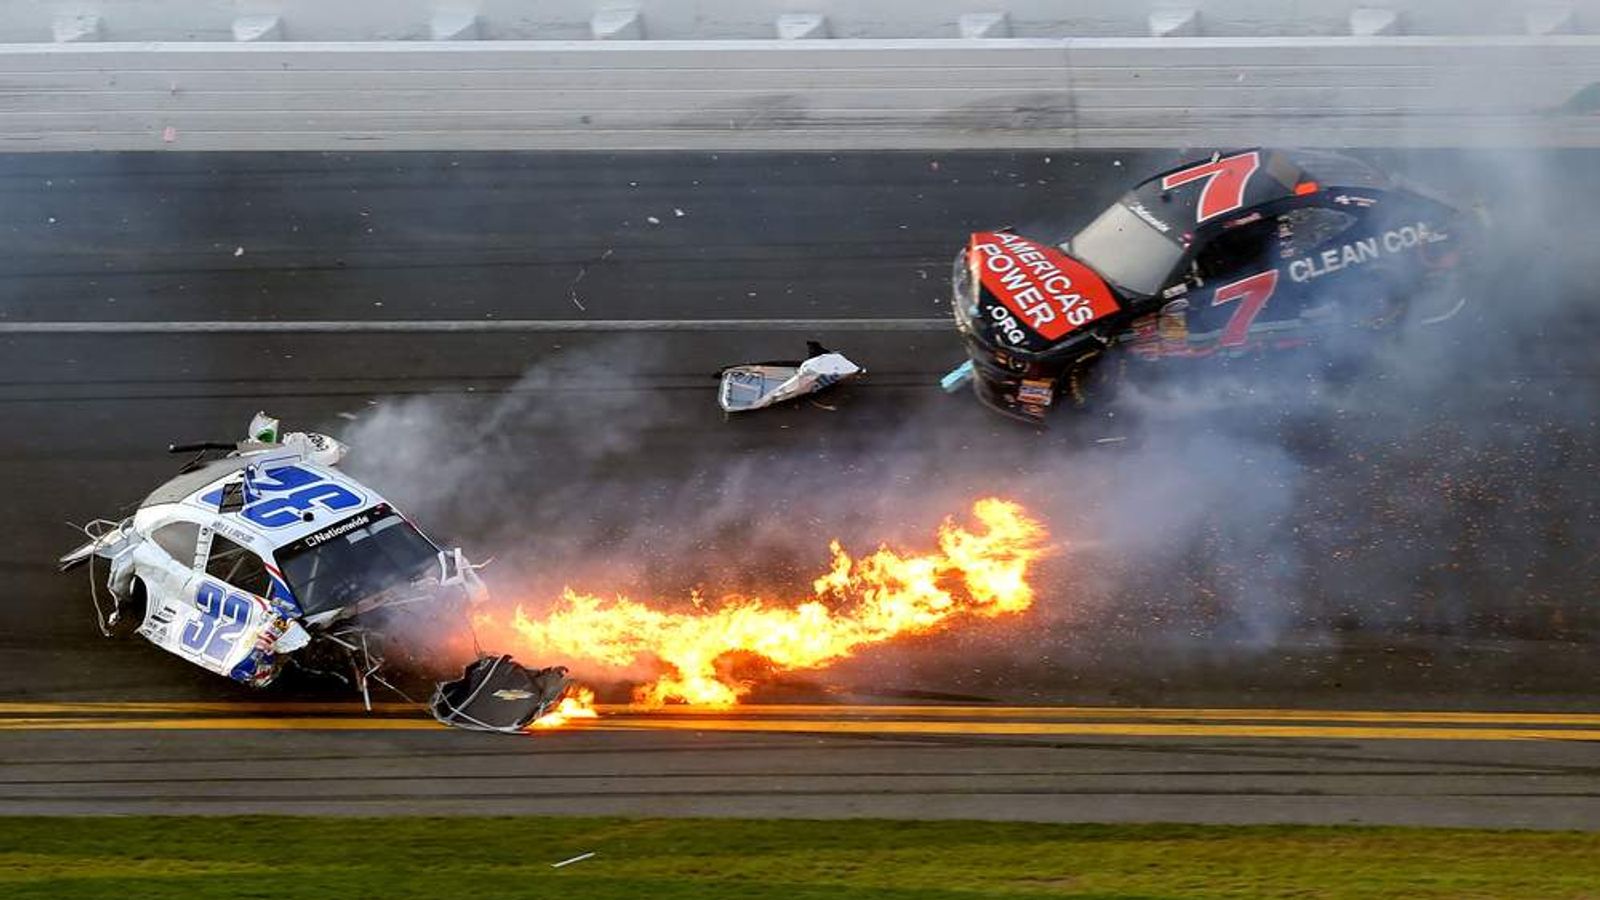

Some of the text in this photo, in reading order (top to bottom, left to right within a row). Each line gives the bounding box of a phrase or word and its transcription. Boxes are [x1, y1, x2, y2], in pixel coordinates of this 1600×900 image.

[1162, 151, 1259, 222] 7
[974, 243, 1056, 328] POWER
[993, 231, 1094, 326] AMERICA'S
[1289, 238, 1379, 283] CLEAN
[1211, 269, 1279, 347] 7
[315, 514, 370, 543] Nationwide
[180, 580, 251, 664] 32
